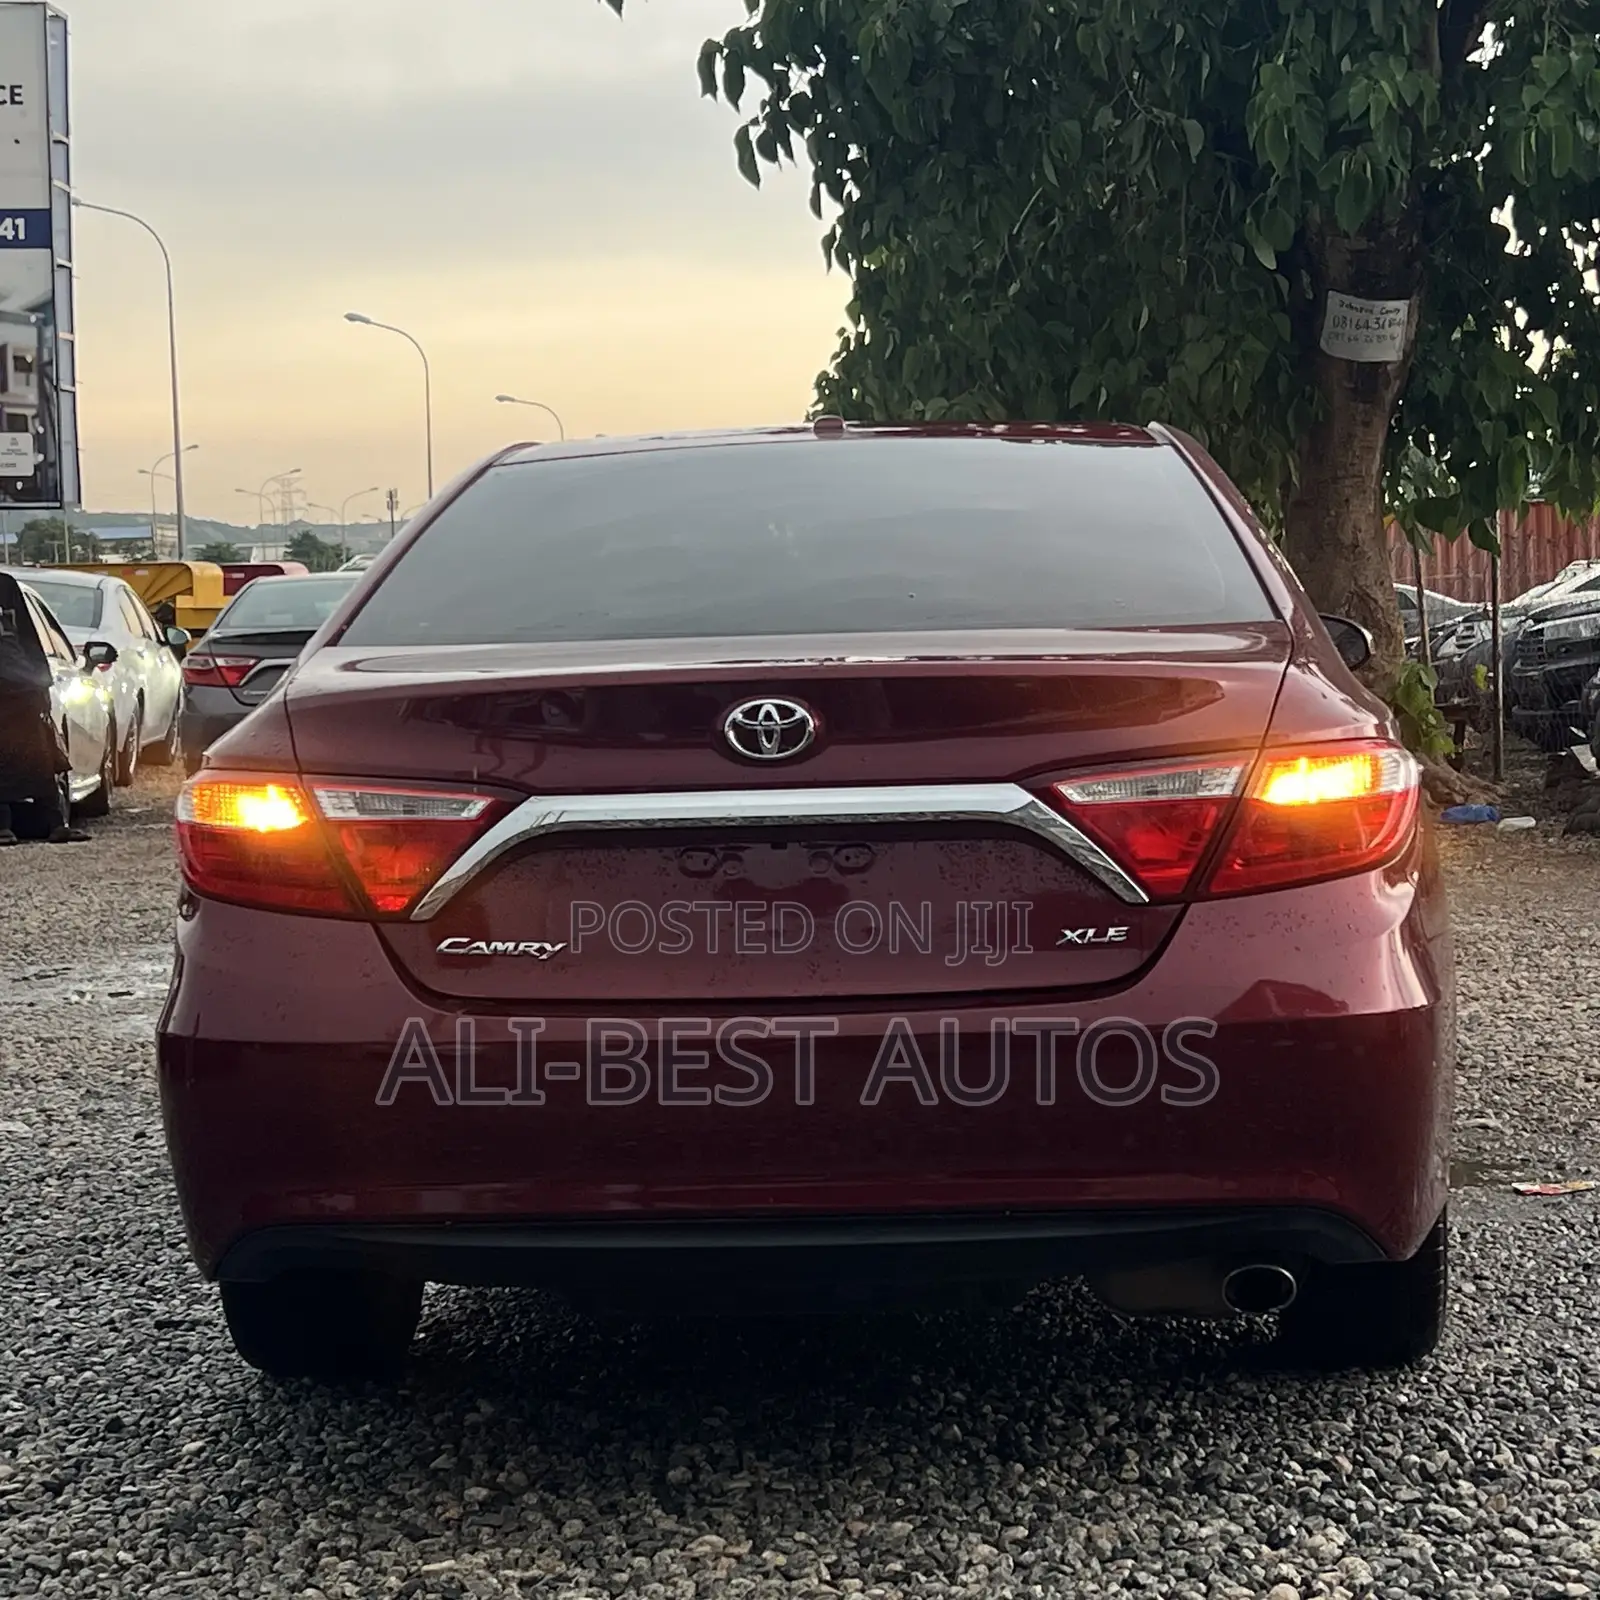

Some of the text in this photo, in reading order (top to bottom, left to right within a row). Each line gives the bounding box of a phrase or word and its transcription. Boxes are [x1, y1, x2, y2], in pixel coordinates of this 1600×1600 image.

[0, 217, 26, 240] 41
[1055, 926, 1130, 946] XLE
[435, 936, 568, 960] CAMRY
